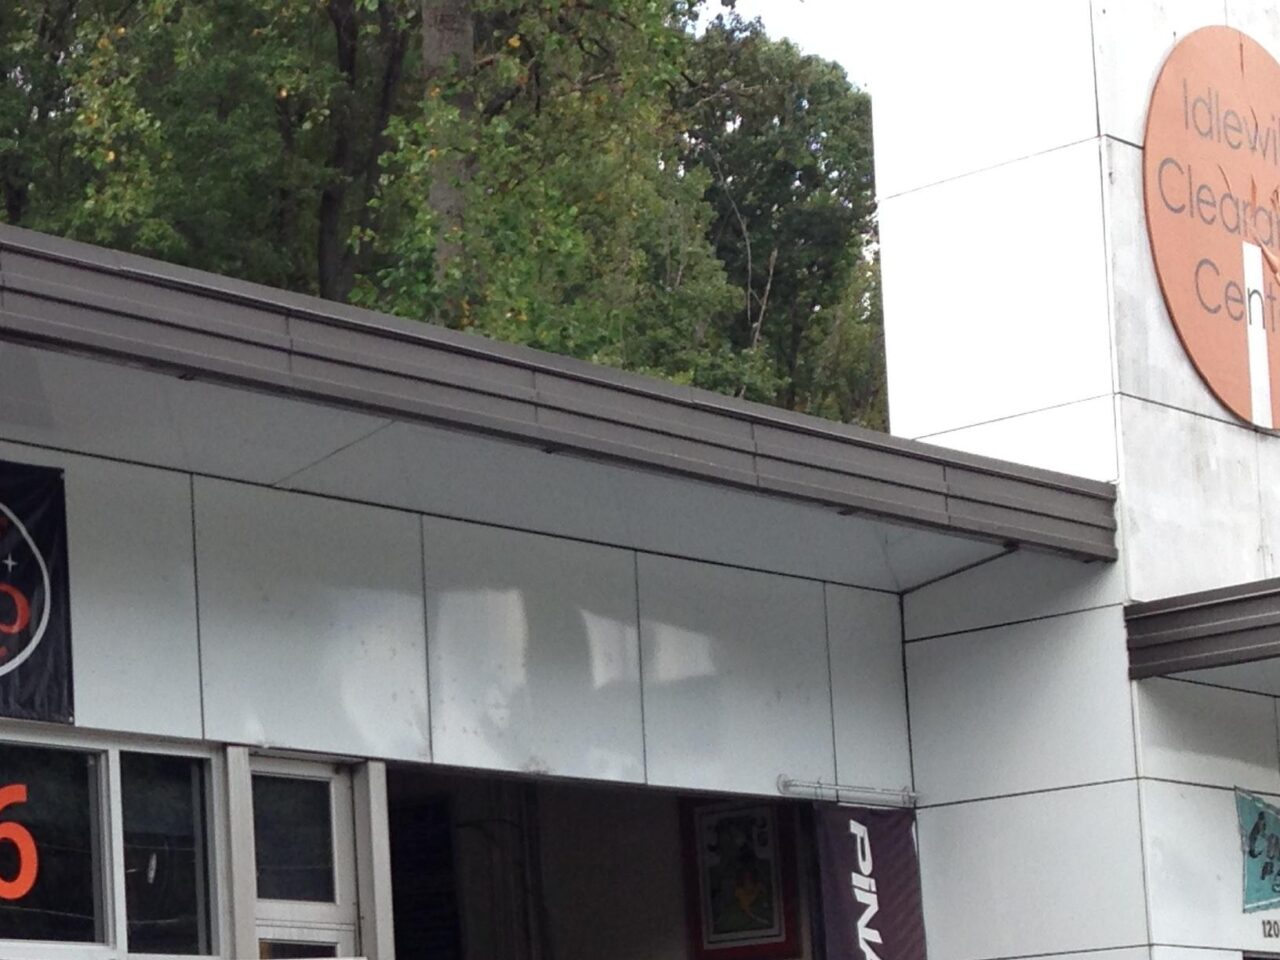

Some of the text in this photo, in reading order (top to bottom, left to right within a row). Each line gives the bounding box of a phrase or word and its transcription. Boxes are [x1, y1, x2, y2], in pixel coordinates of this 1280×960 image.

[1183, 78, 1280, 167] Idlewi
[1157, 157, 1280, 248] Cleara
[1194, 258, 1280, 334] Cent
